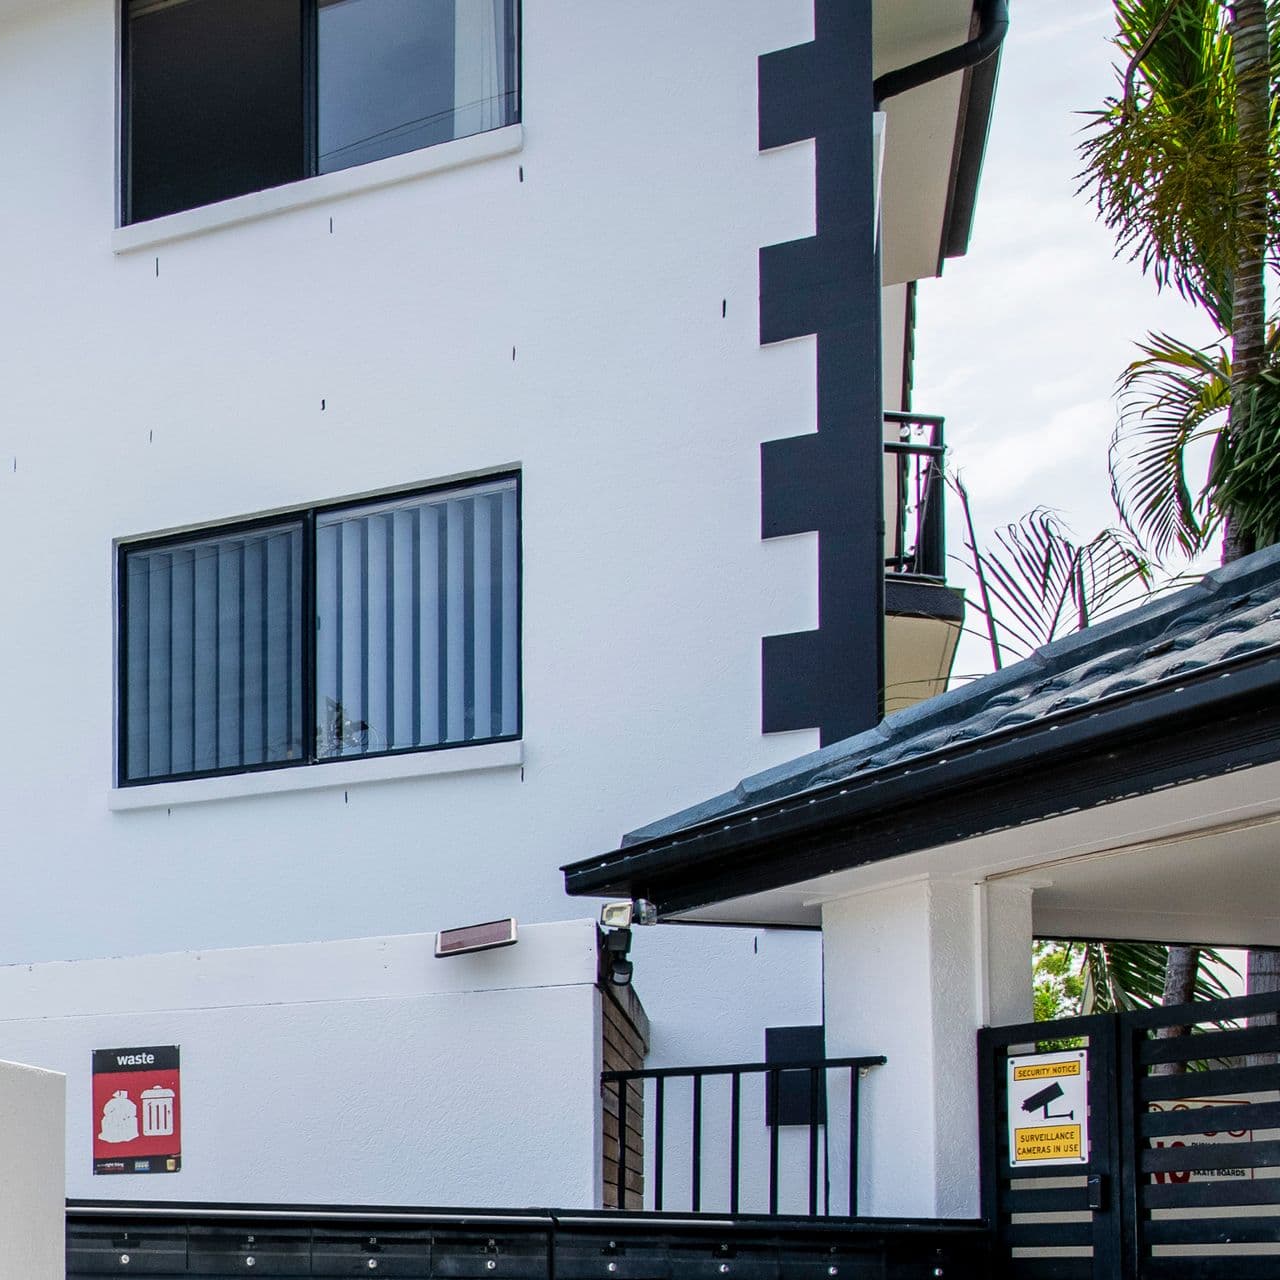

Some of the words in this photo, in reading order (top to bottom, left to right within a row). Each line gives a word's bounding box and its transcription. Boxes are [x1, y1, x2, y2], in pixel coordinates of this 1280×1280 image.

[116, 1052, 155, 1066] waste
[1018, 1068, 1050, 1078] SECURITY
[1052, 1064, 1077, 1074] NOTICE
[1020, 1131, 1075, 1143] SURVEILLANCE
[1017, 1145, 1051, 1156] CAMERAS
[1053, 1144, 1061, 1153] IN
[1063, 1143, 1079, 1152] USE
